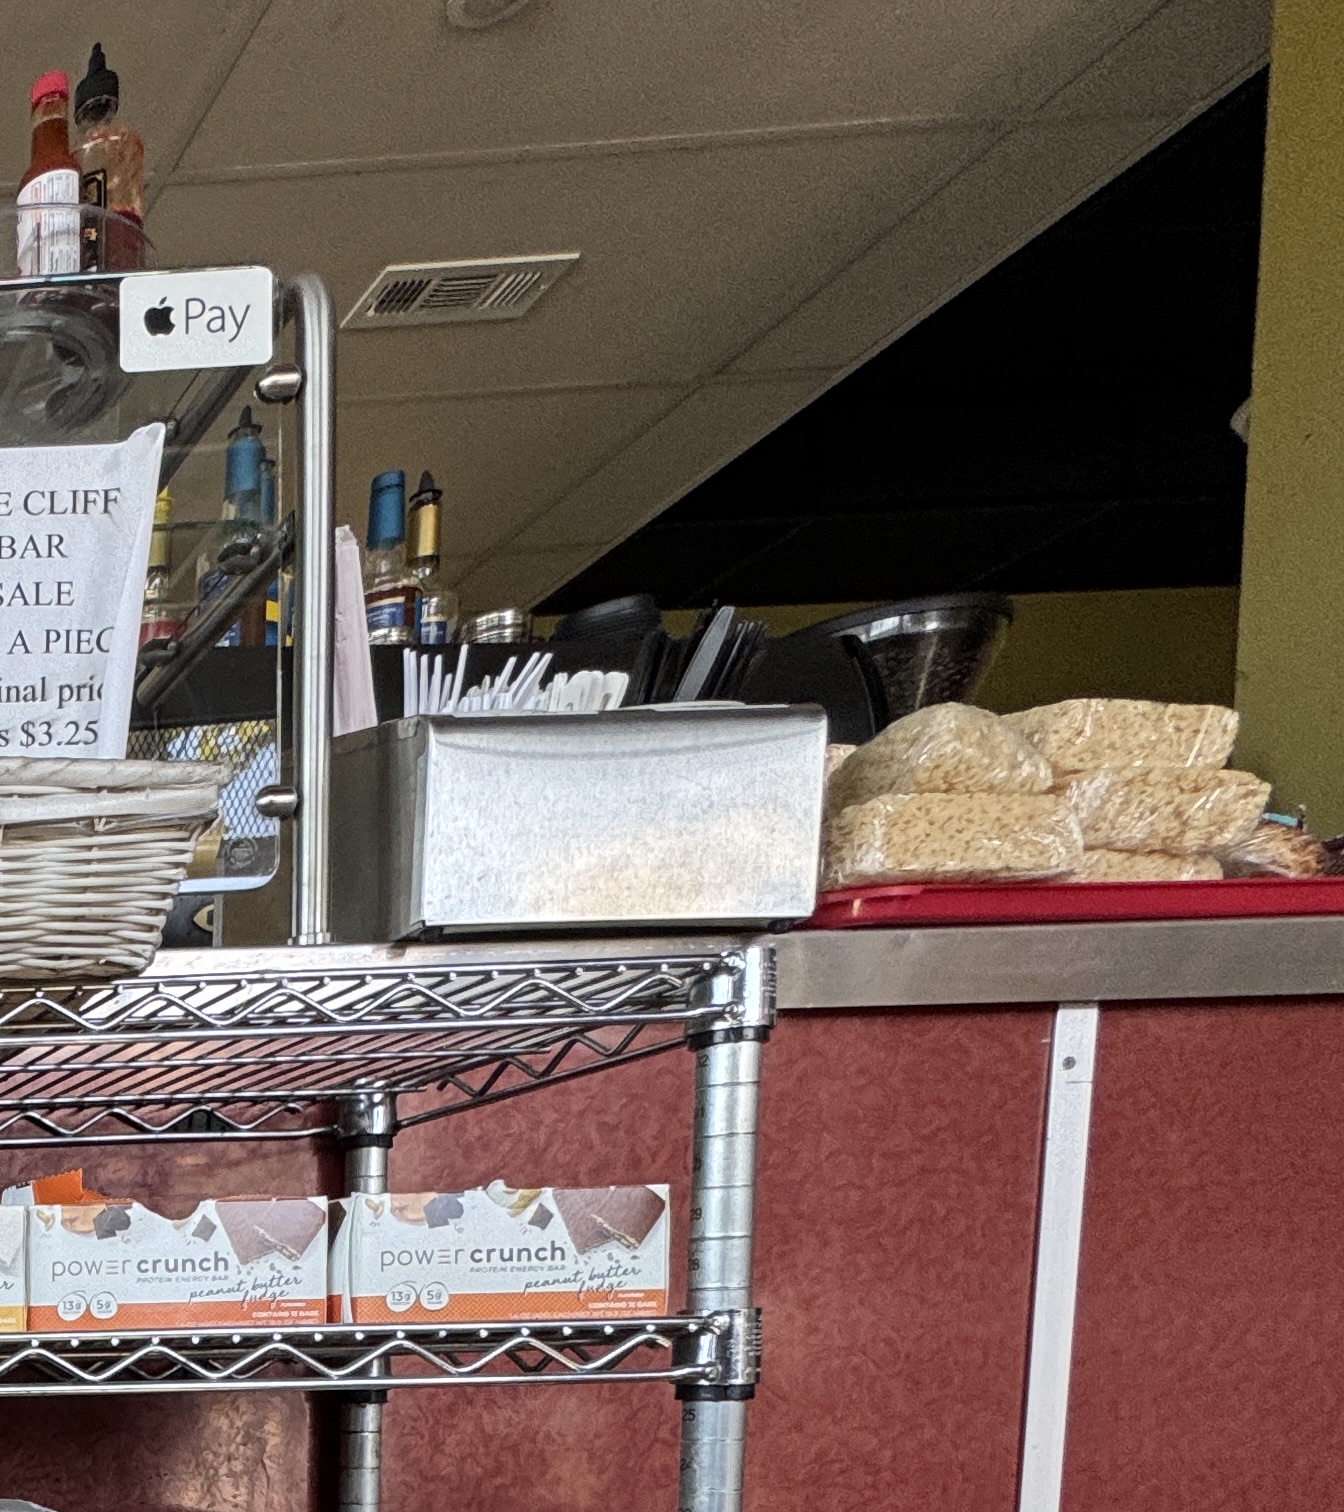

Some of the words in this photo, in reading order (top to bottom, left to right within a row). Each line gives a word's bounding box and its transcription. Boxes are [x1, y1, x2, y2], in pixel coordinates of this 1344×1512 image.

[185, 298, 250, 342] Pay
[23, 487, 121, 516] CLIFF
[8, 630, 31, 655] A
[20, 720, 98, 749] $3.25
[137, 1251, 228, 1273] crunch
[470, 1240, 565, 1263] crunch
[251, 1276, 302, 1292] butter
[588, 1266, 641, 1284] butter
[682, 1409, 695, 1421] 25
